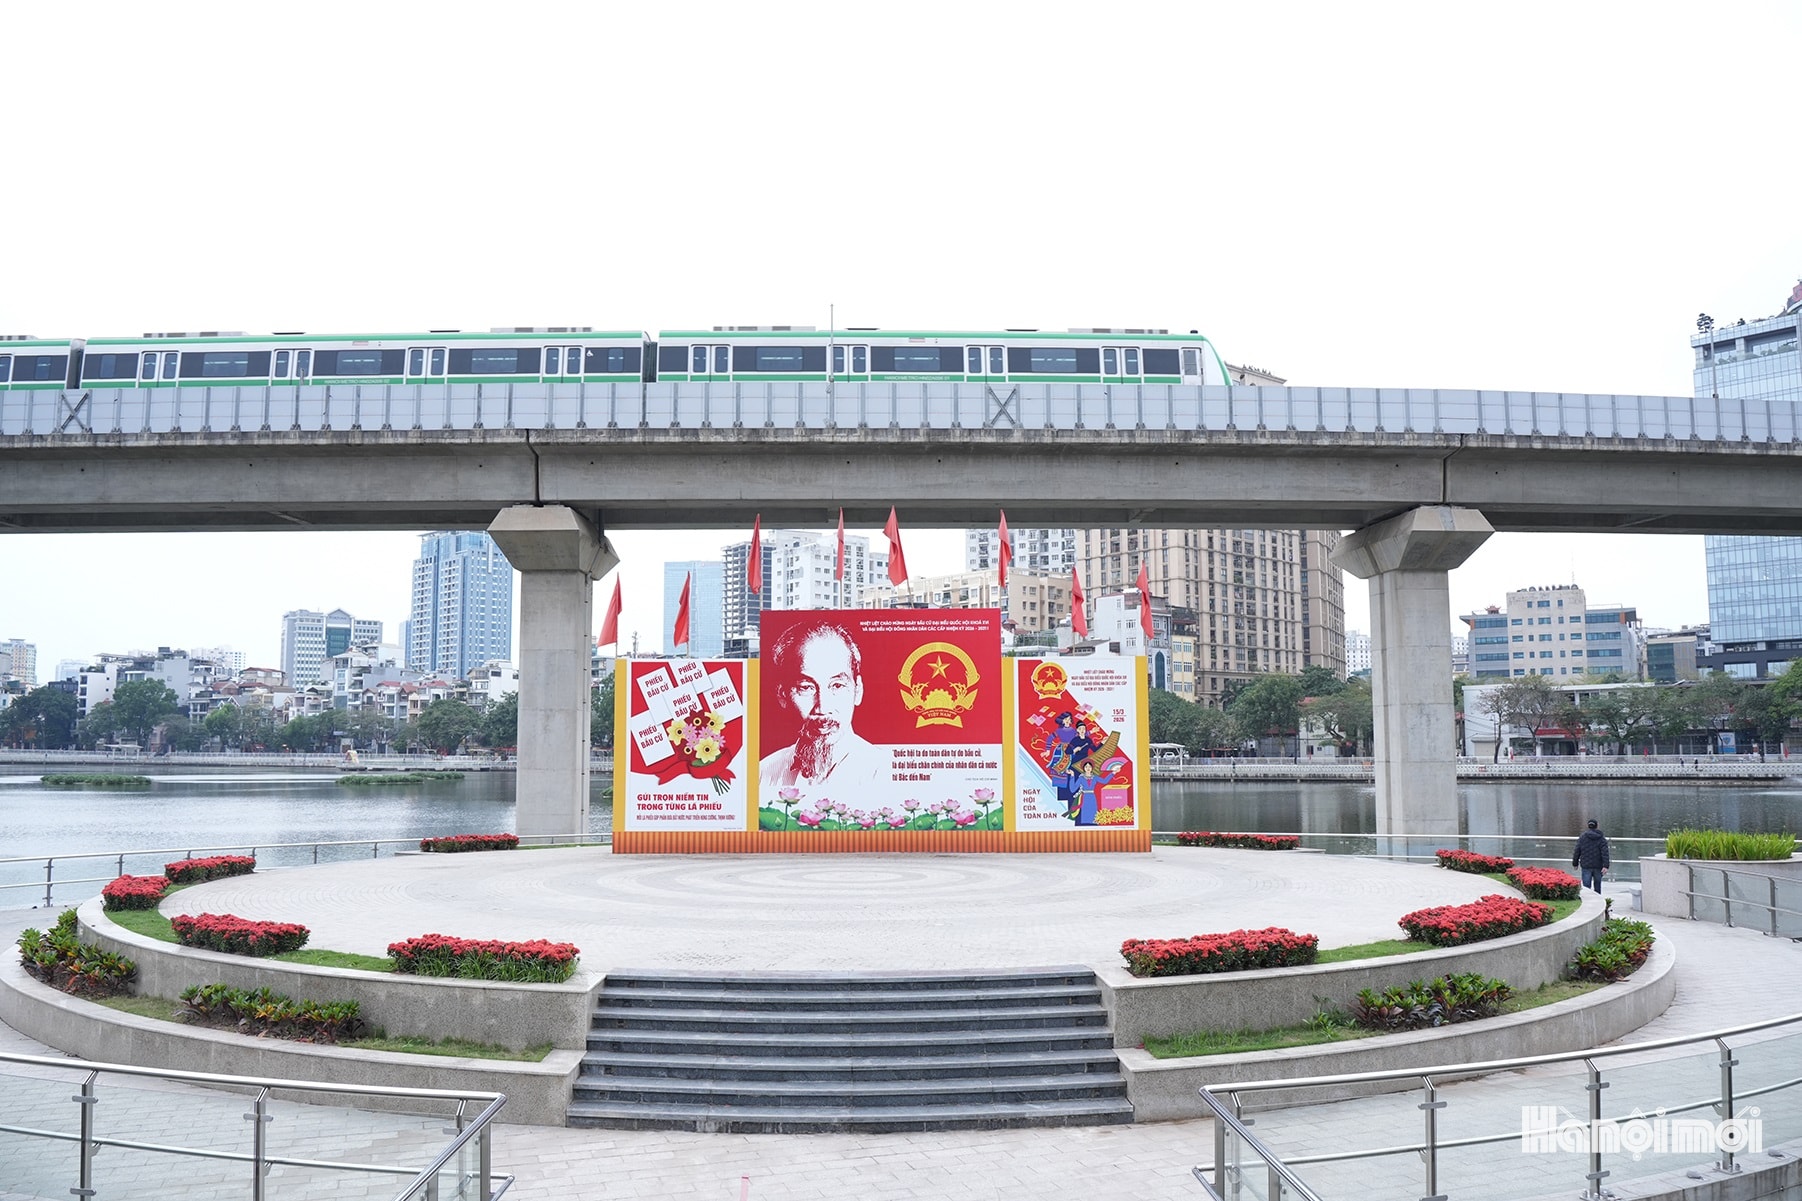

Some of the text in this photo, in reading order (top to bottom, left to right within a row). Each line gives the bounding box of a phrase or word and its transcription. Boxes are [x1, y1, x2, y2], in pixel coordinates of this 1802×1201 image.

[678, 661, 697, 674] PHIẾU
[645, 675, 663, 687] PHIẾU
[680, 669, 703, 685] BẦU CỬ
[647, 682, 670, 698] BẦU CỬ
[711, 686, 729, 699] PHIẾU
[673, 694, 691, 707] PHIẾU
[713, 693, 735, 709] BẦU CỬ
[675, 707, 688, 717] BẦU
[639, 725, 657, 738] PHIẾU
[641, 732, 663, 748] BẦU CỬ
[965, 748, 973, 757] bầu
[906, 760, 917, 768] biểu
[899, 773, 908, 781] Bắc
[909, 772, 918, 781] đến
[637, 792, 651, 801] GỬI
[676, 792, 694, 801] NIỀM
[665, 802, 686, 810] TỪNG
[688, 802, 697, 810] LÁ
[699, 801, 722, 810] PHIẾU
